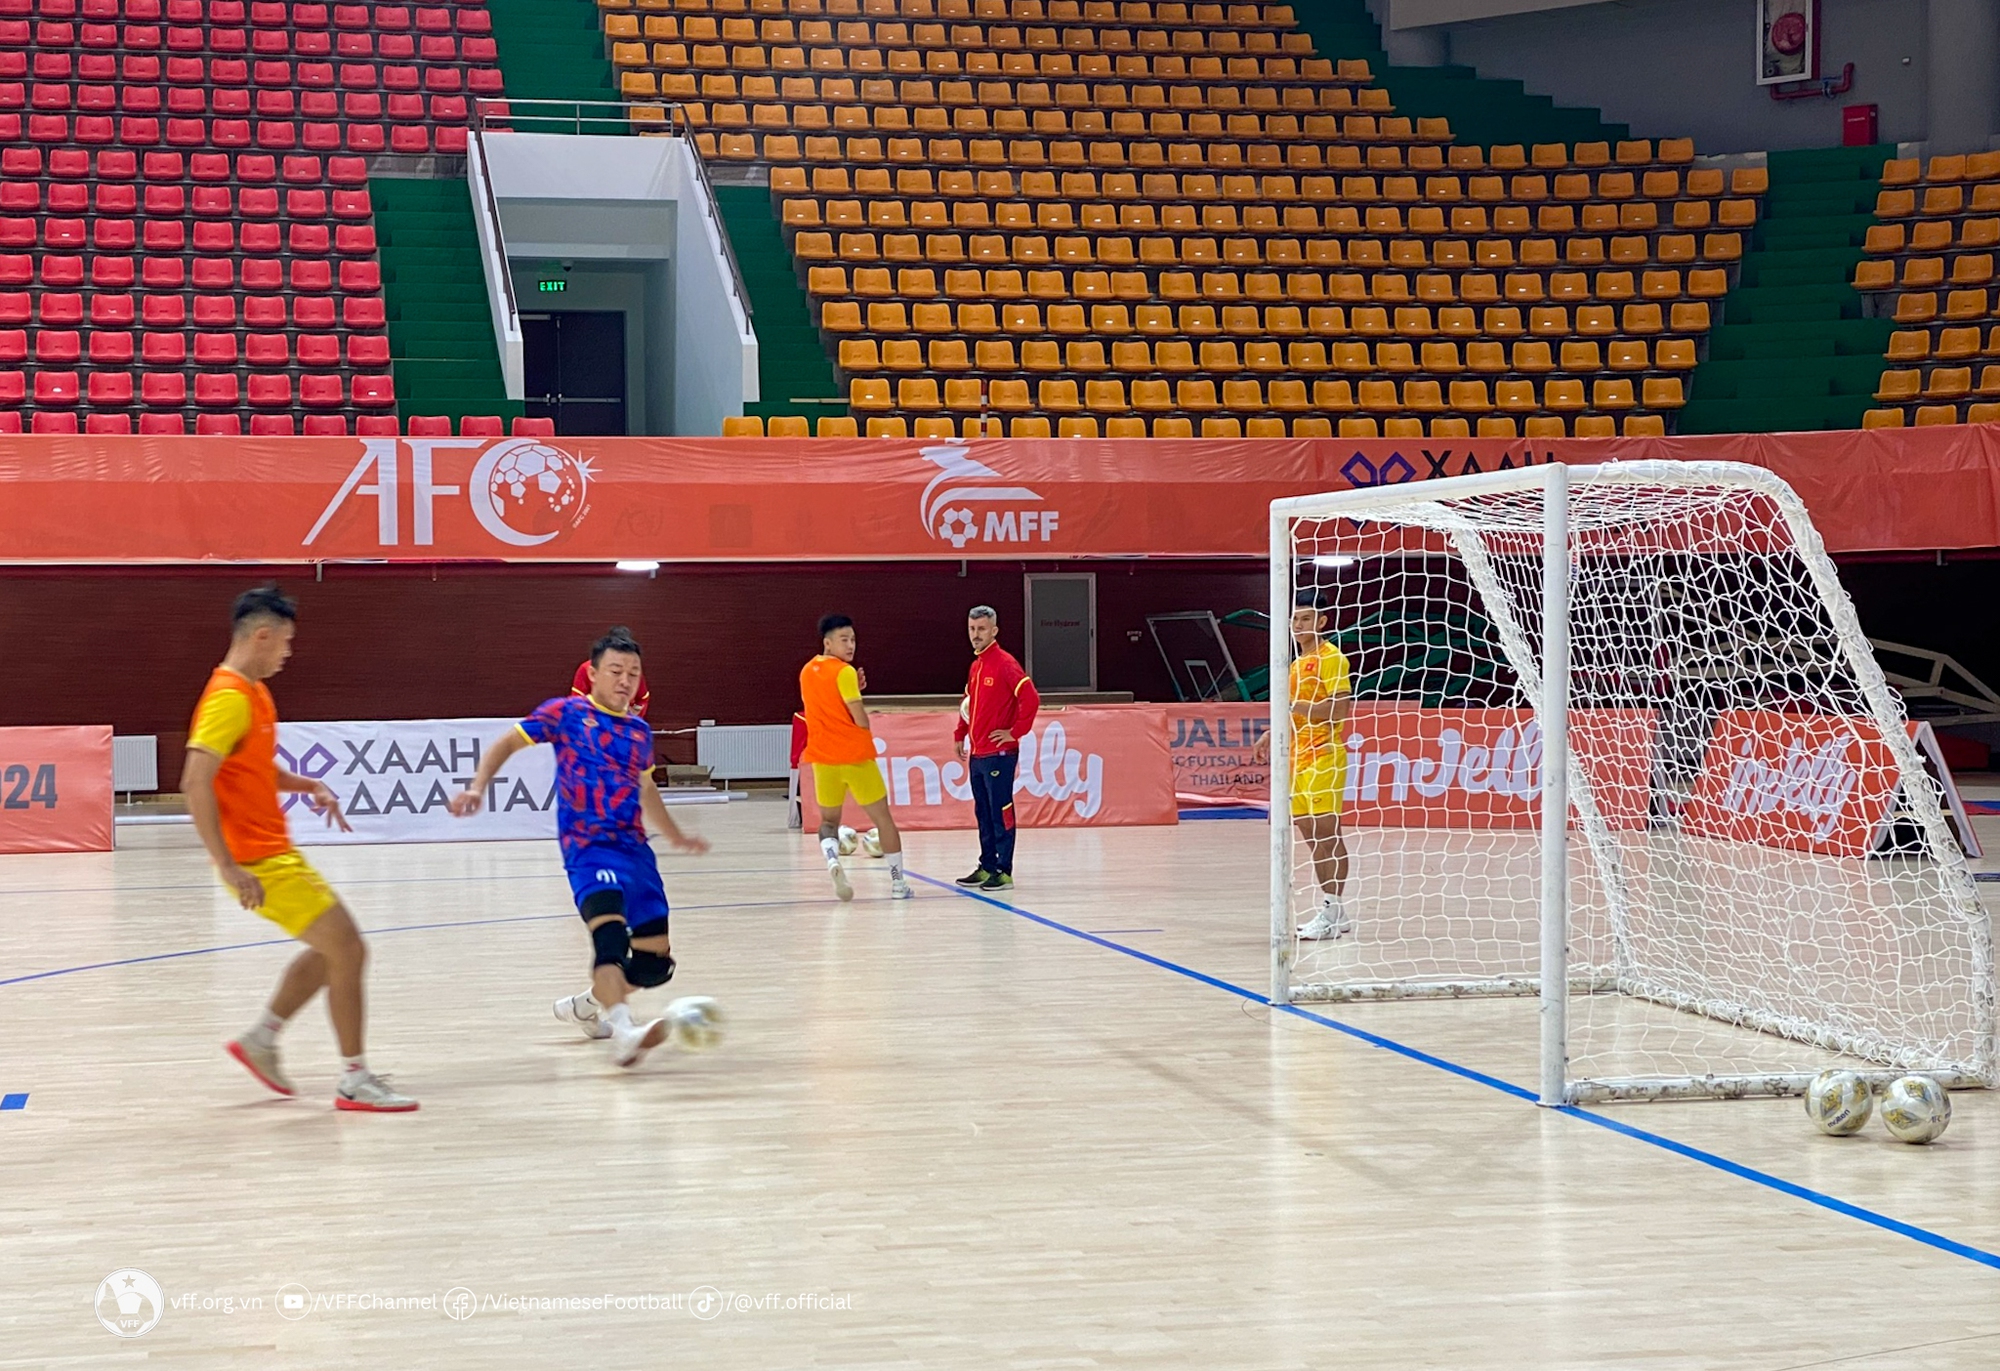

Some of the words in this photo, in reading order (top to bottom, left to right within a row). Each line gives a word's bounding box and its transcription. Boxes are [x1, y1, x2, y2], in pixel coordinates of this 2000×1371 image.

[540, 281, 565, 291] EXIT
[301, 438, 560, 546] AFC
[983, 511, 1059, 542] MFF
[1187, 755, 1247, 768] FUTSAL
[0, 763, 58, 810] 24
[1190, 773, 1265, 786] THAILAND
